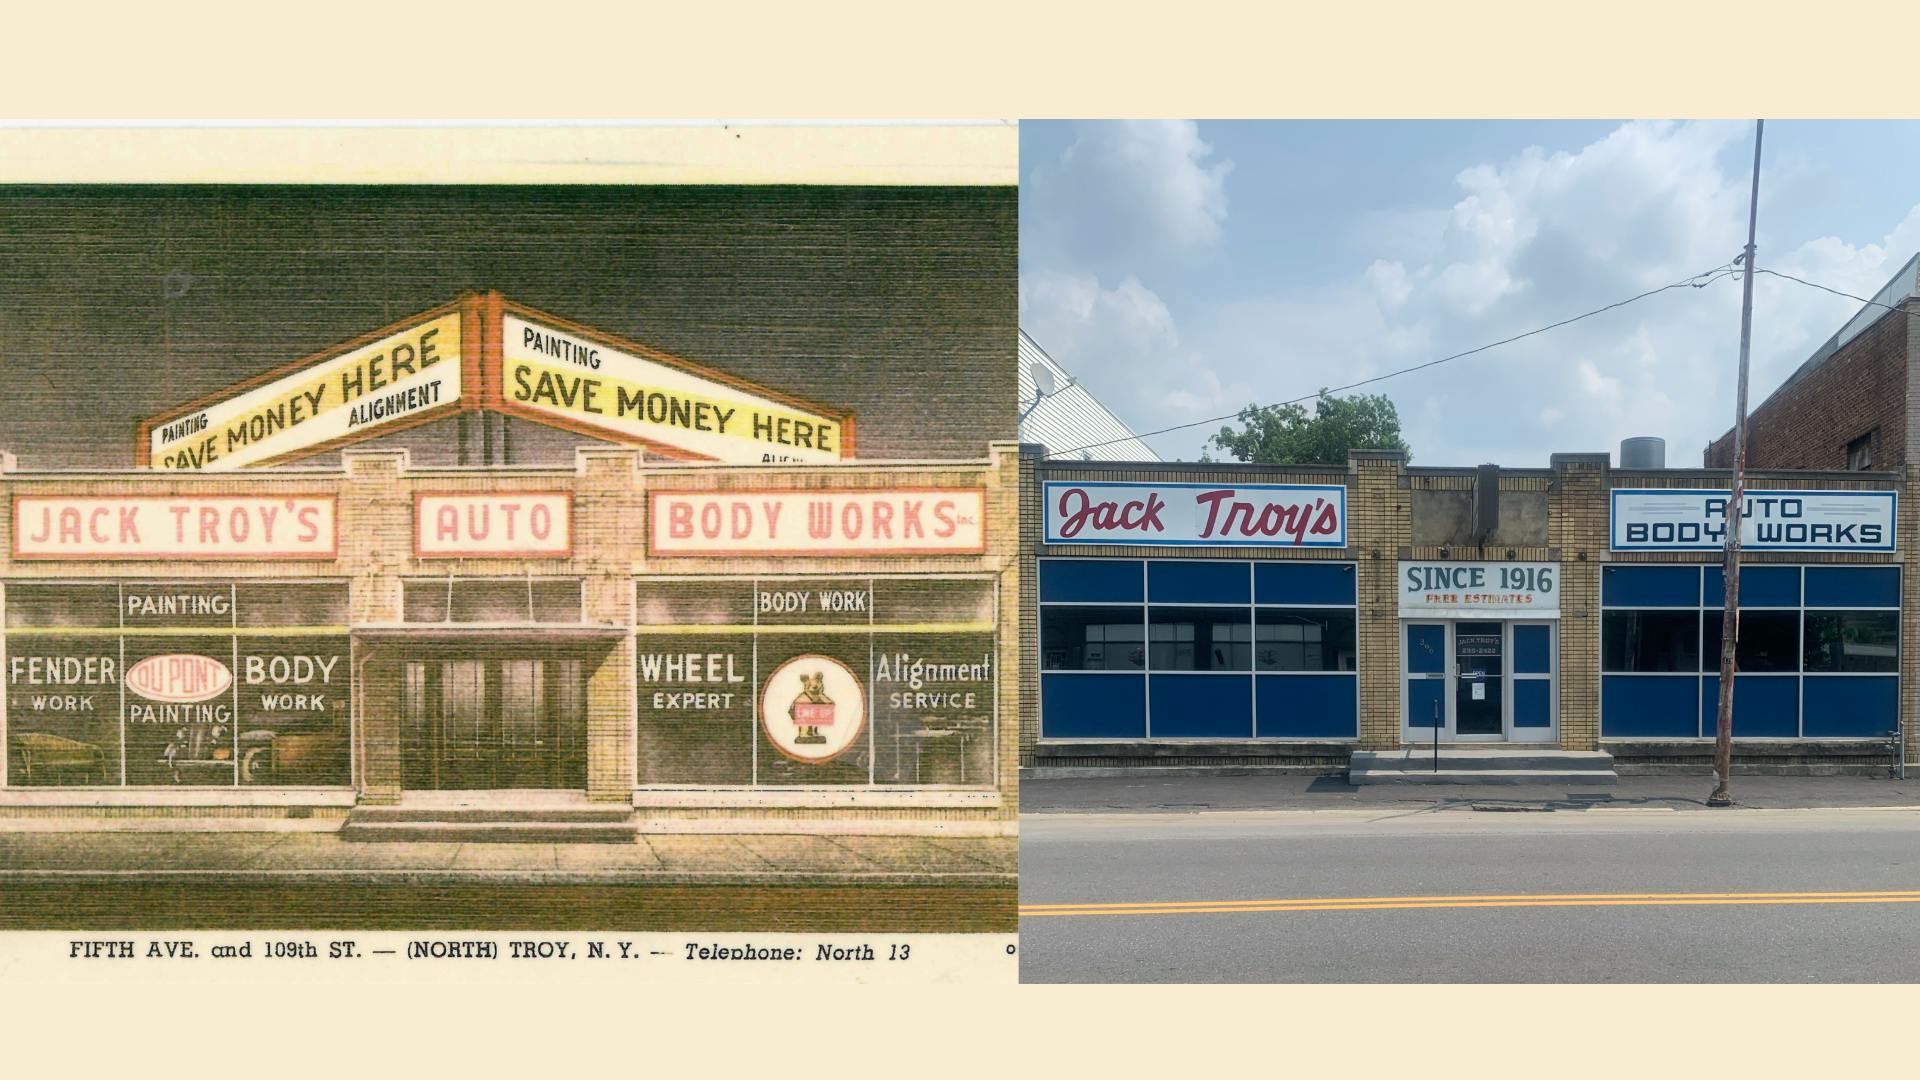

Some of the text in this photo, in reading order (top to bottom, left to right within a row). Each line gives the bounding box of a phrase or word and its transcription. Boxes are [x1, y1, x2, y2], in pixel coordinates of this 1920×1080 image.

[523, 327, 601, 370] PAINTING
[227, 384, 326, 453] MONEY
[342, 327, 441, 403] HERE
[348, 380, 443, 428] ALIGNMENT
[514, 365, 832, 451] SAVE MONEY HERE
[162, 413, 208, 444] PAINTING
[30, 499, 320, 545] JACK TROY'S
[436, 503, 551, 541] AUTO
[669, 501, 783, 539] BODY
[807, 500, 956, 539] WORKS
[1059, 488, 1338, 546] Jack Troy's
[1626, 522, 1882, 543] BODY WORKS
[1407, 566, 1553, 593] SINCE 1916
[127, 595, 230, 615] PAINTING
[760, 591, 867, 612] BODY WORK
[1425, 593, 1533, 604] FREE ESTIMATES
[11, 656, 116, 685] FENDER
[138, 658, 221, 693] DU PONT
[245, 655, 339, 684] BODY
[640, 653, 745, 682] WHEEL
[876, 653, 991, 689] Alignment
[31, 695, 95, 710] WORK
[130, 704, 232, 723] PAINTING
[261, 694, 325, 711] WORK
[653, 692, 735, 710] EXPERT
[889, 692, 976, 709] SERVICE
